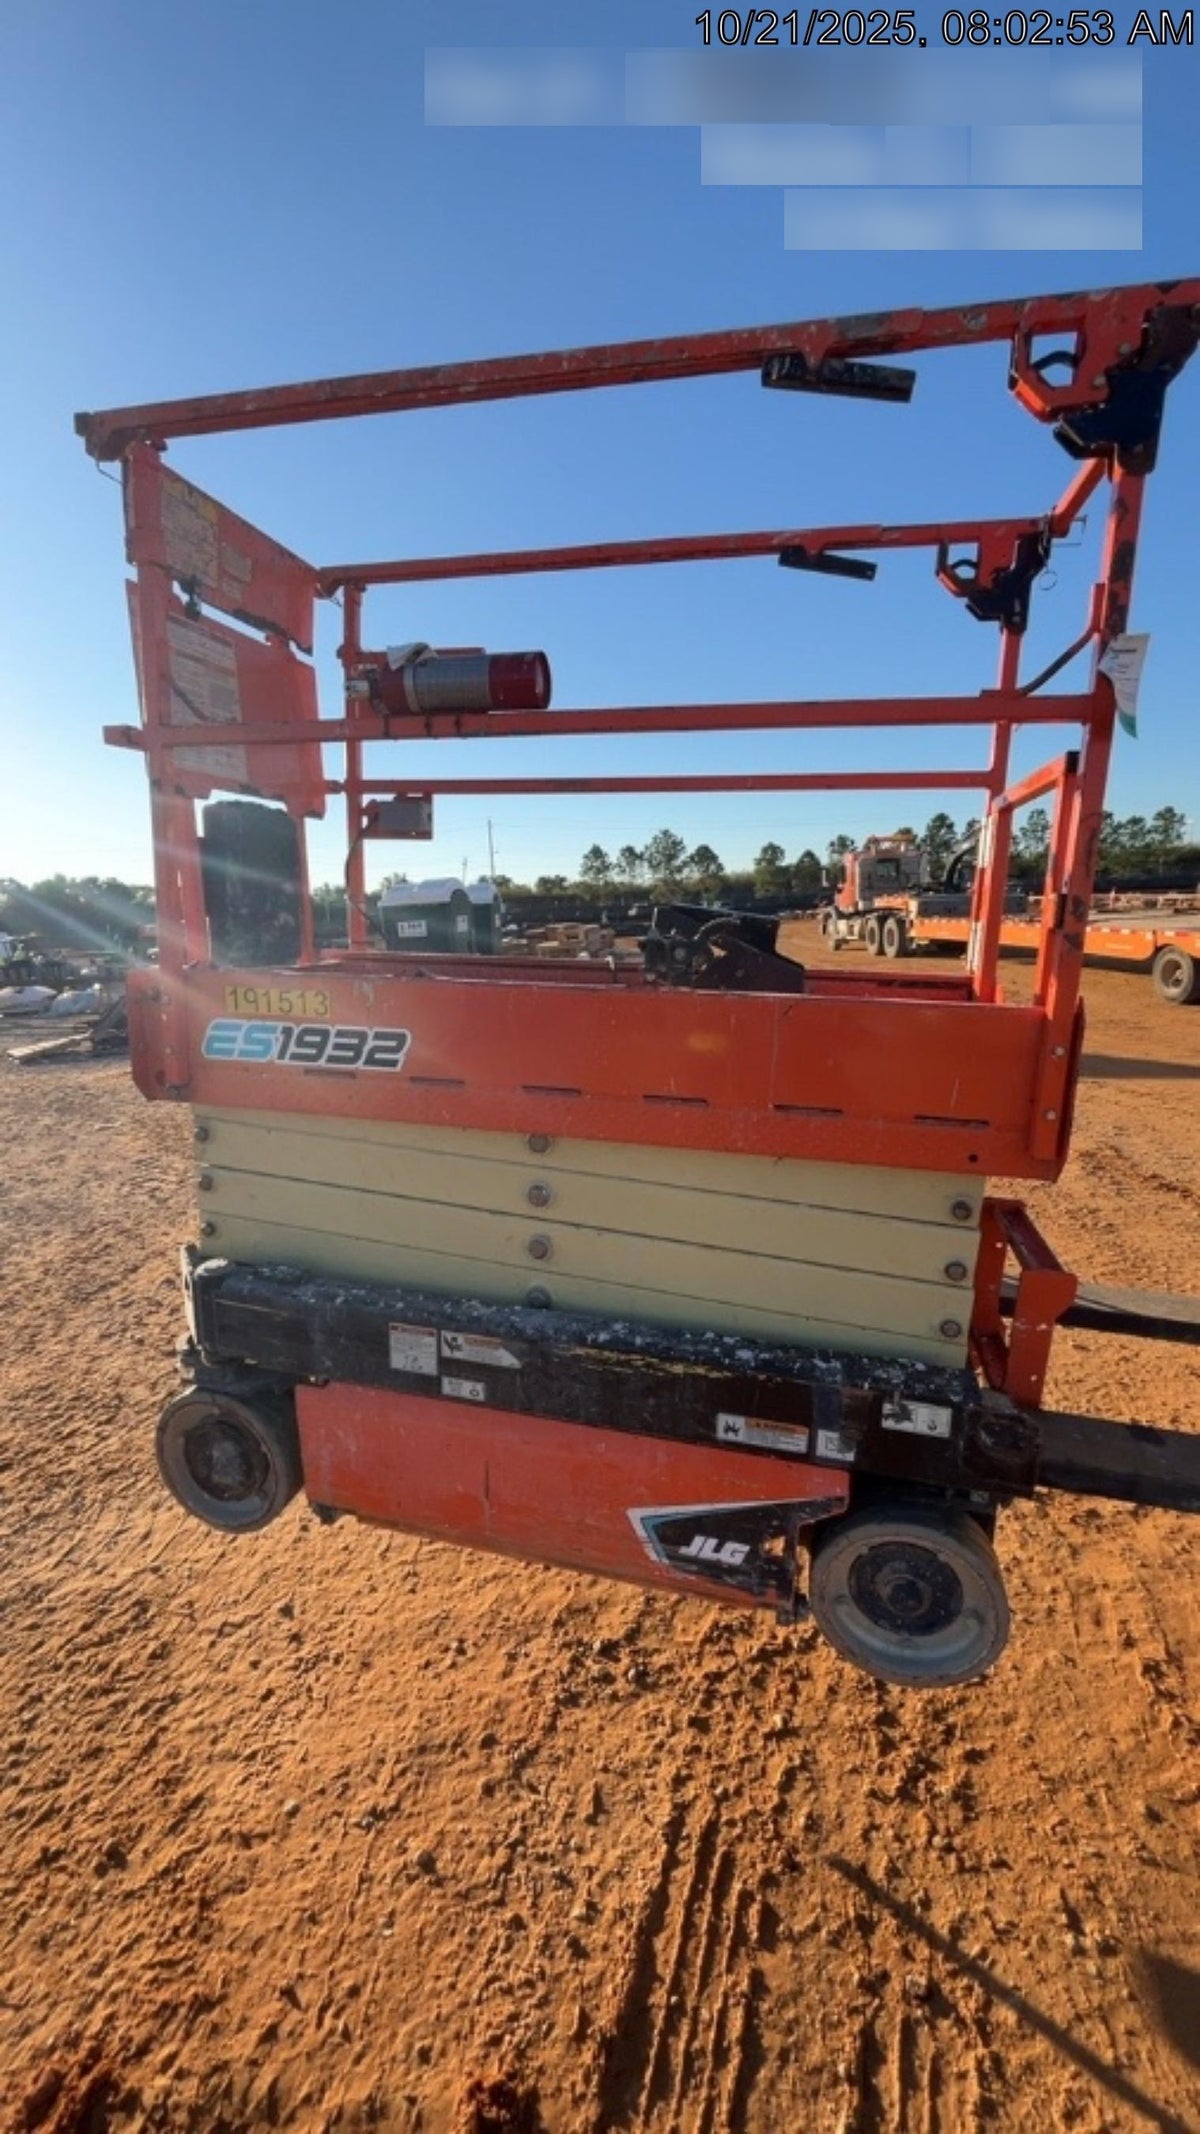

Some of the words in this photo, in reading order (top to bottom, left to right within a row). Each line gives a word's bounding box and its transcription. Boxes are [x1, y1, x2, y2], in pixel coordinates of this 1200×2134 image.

[228, 986, 329, 1016] 191513
[202, 1018, 411, 1072] ES1932
[678, 1535, 751, 1566] JLG
